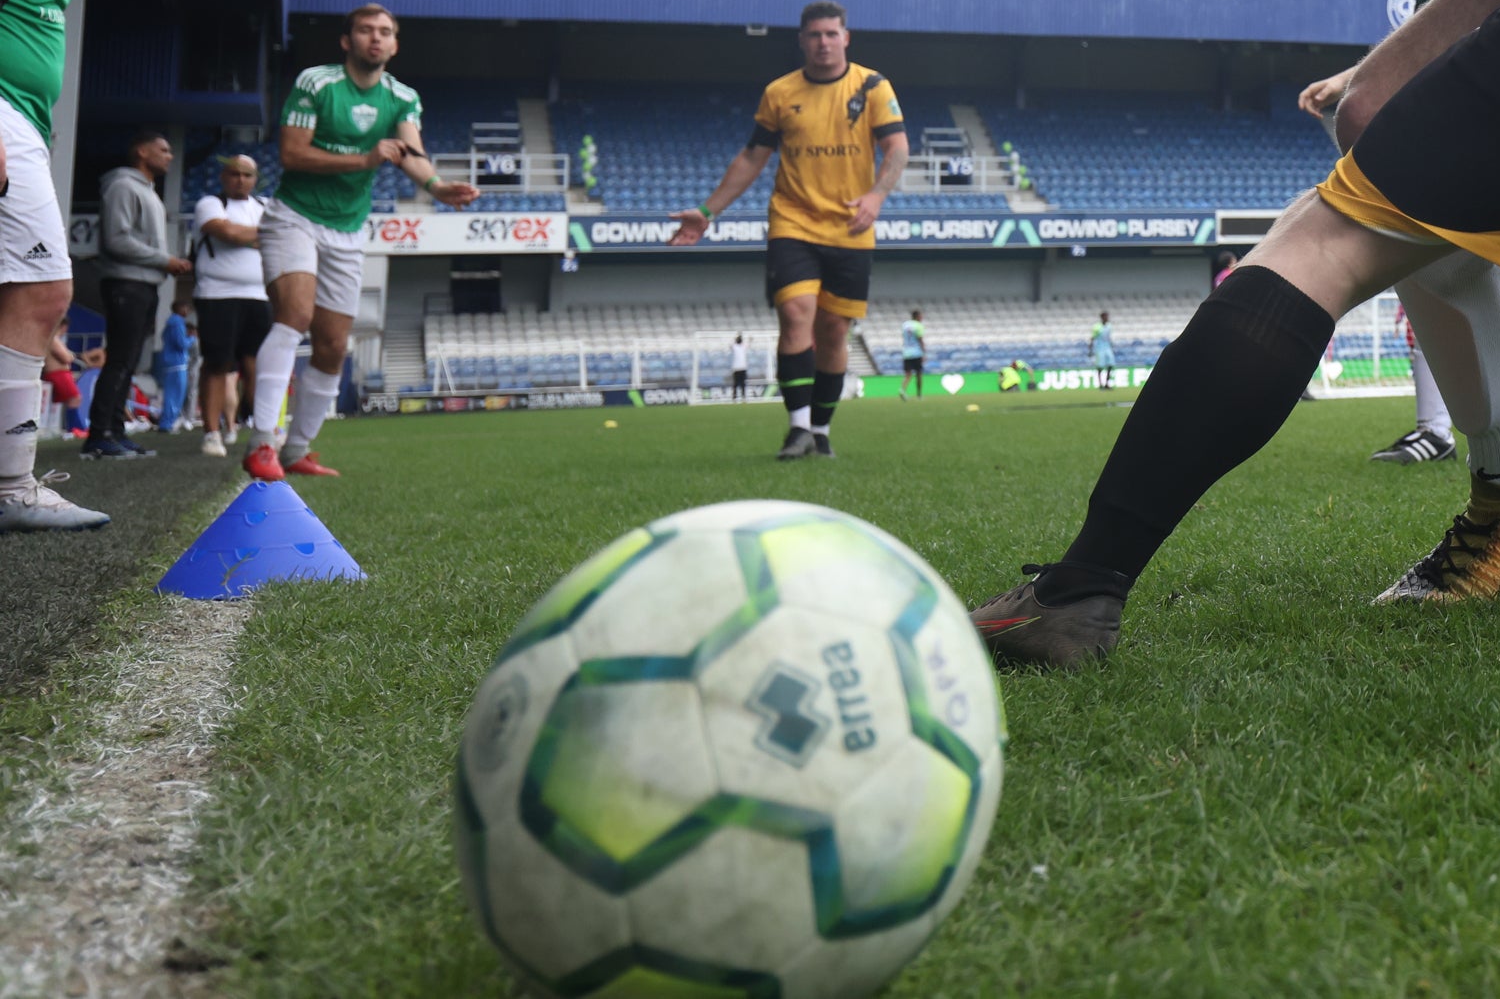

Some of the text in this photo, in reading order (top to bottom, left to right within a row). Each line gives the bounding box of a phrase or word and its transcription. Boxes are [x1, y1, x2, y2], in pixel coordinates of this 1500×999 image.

[367, 218, 421, 242] Yex
[705, 221, 769, 241] URSE
[875, 219, 999, 240] ING PURSEY
[1039, 218, 1199, 238] GOWING PURSEY
